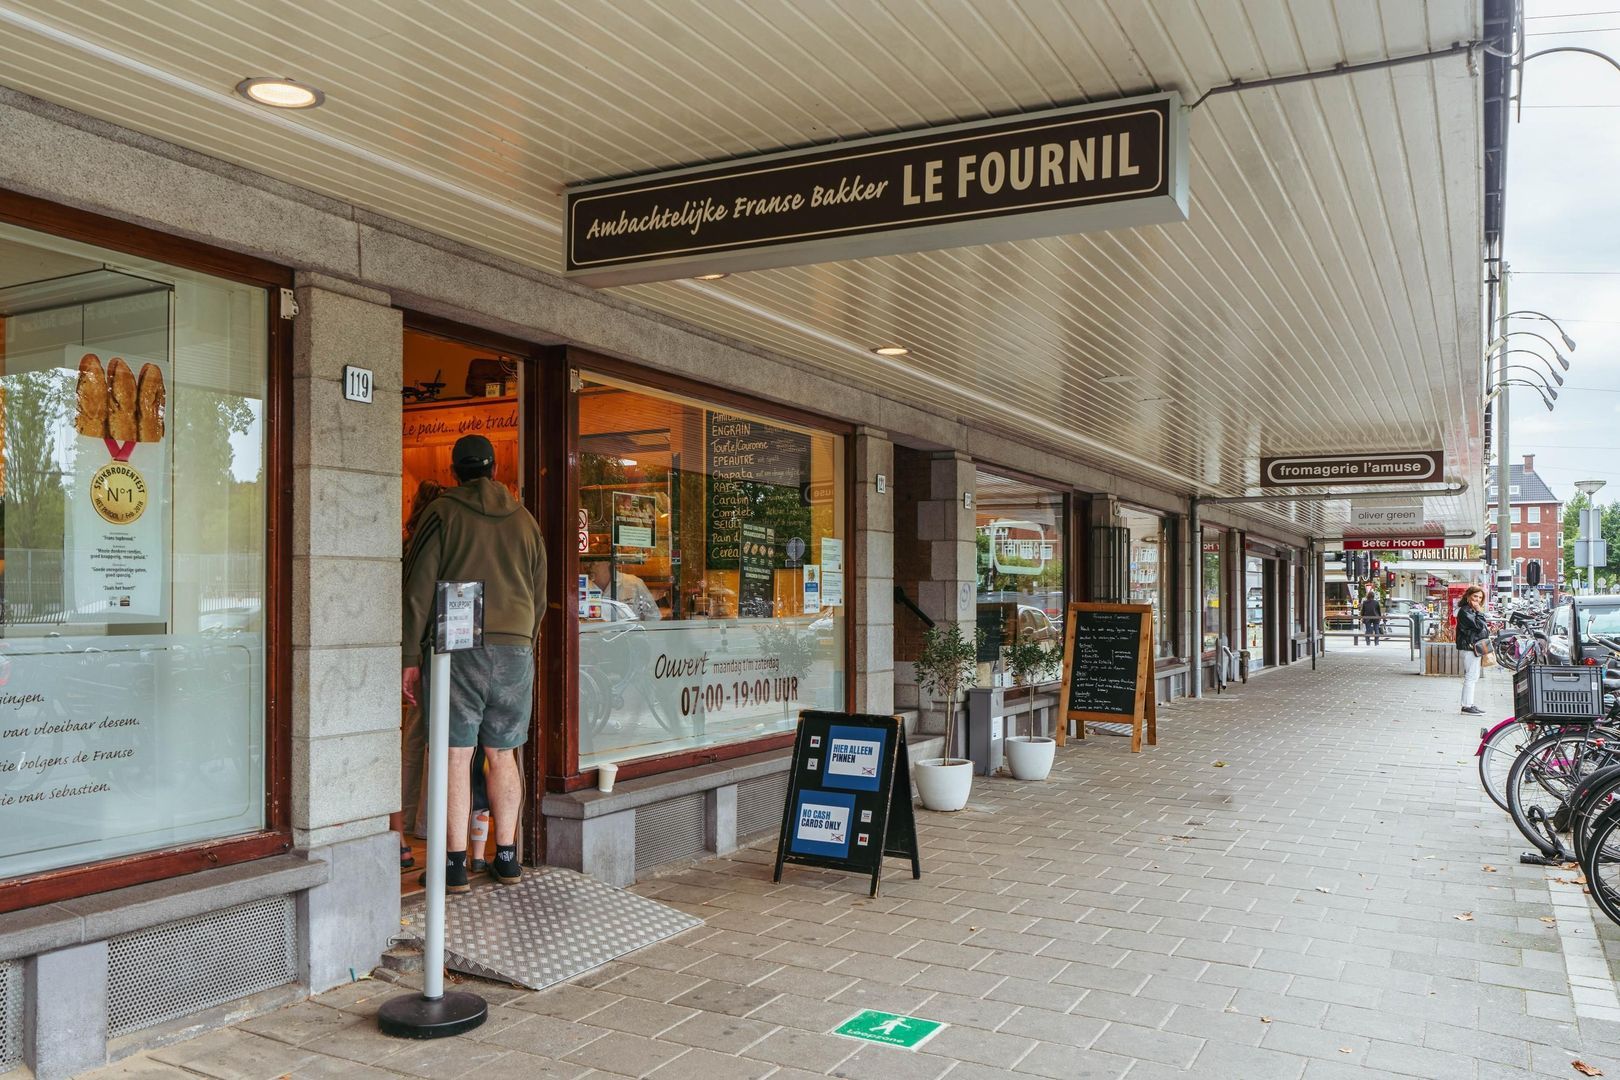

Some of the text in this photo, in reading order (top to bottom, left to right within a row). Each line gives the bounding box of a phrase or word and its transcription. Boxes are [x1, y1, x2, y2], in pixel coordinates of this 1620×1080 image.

[586, 132, 1140, 239] Ambachtelijke Franse Bakker LE FOURNIL
[350, 371, 369, 398] 119
[712, 423, 751, 436] ENGRAIN
[713, 454, 755, 467] EPEAUTRE
[712, 467, 753, 482] Chapata
[1280, 462, 1421, 477] fromagerie l'amuse
[1358, 511, 1416, 522] oliver green
[712, 532, 731, 543] Pain
[1413, 547, 1468, 560] SPAGHETTERIA
[655, 651, 709, 679] Ouvert
[714, 660, 741, 675] maandag
[755, 657, 780, 672] zaterdag
[774, 676, 798, 702] UUR
[3, 716, 140, 738] van vloeibaar desem.
[833, 744, 873, 756] HIER ALLEEN
[19, 755, 69, 774] volgens
[72, 751, 89, 763] de
[93, 748, 134, 762] Franse
[832, 753, 856, 763] PINNEN
[19, 791, 45, 803] van
[49, 782, 111, 799] Sebastien.
[802, 809, 831, 820] NO CASH
[801, 818, 841, 831] CARDS ONLY
